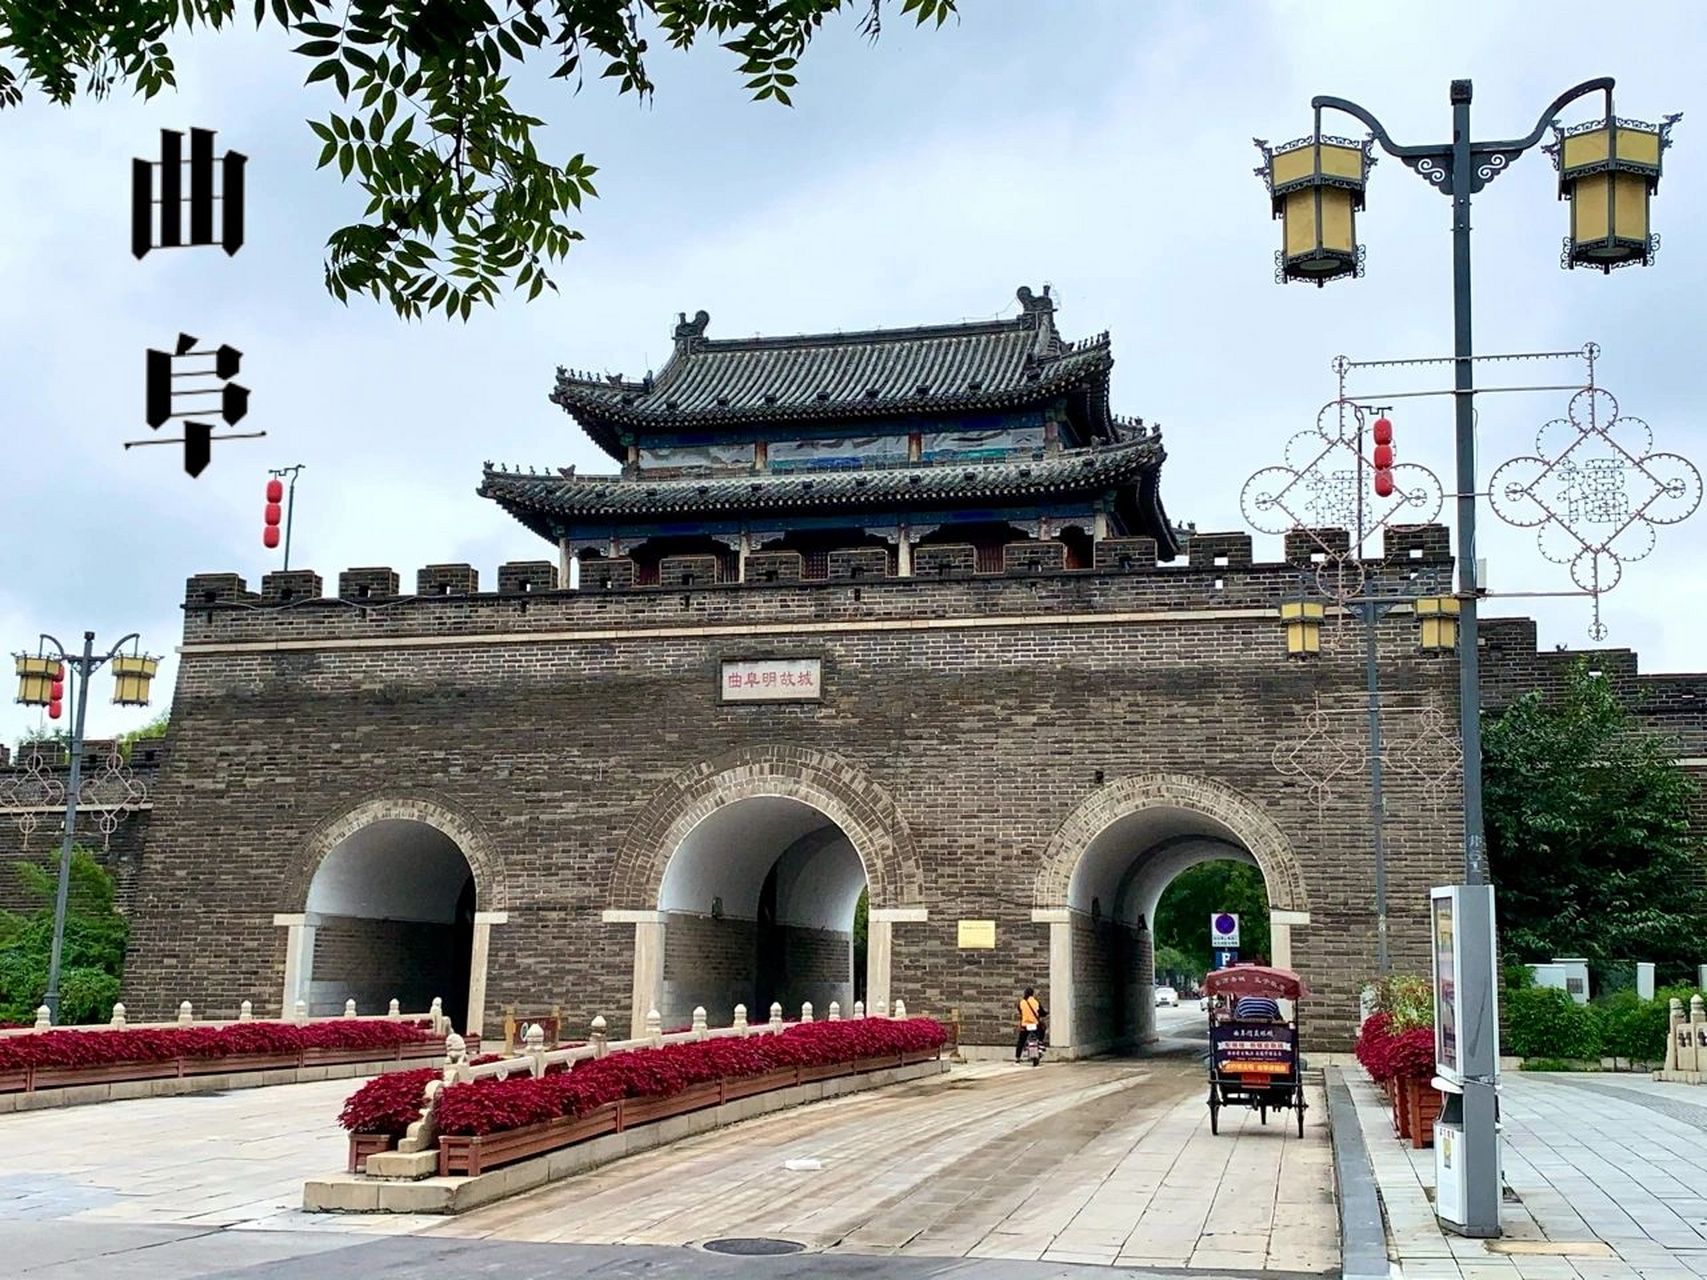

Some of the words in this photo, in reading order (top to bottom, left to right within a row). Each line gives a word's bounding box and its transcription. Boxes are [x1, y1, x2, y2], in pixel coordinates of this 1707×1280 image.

[728, 670, 813, 688] 曲阜明故城
[1221, 952, 1231, 966] P
